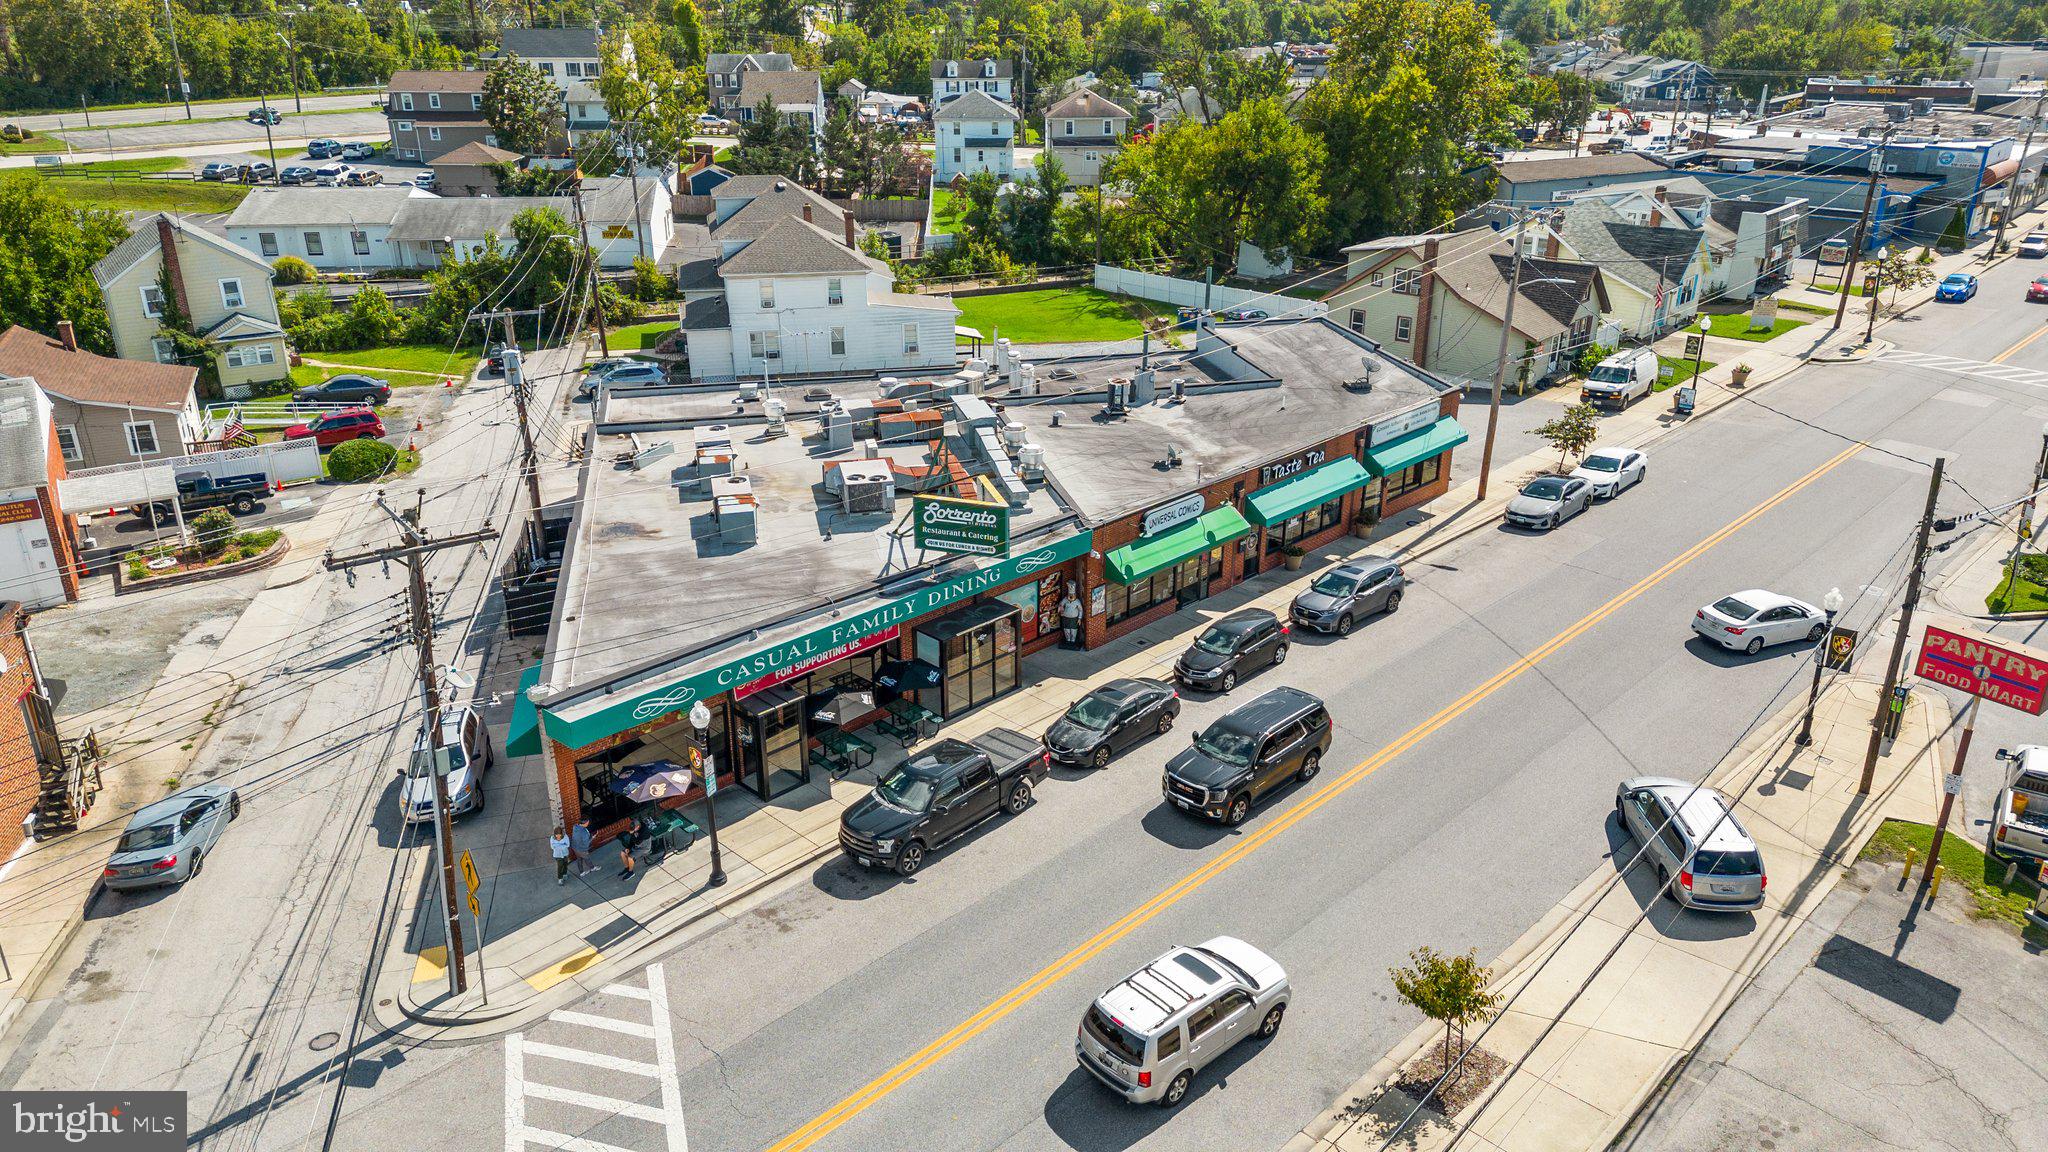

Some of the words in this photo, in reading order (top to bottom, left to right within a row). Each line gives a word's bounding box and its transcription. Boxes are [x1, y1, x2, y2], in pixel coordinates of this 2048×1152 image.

[1271, 458, 1302, 479] Taste
[1305, 450, 1325, 466] Tea
[923, 502, 997, 524] Sorrento
[1149, 509, 1177, 529] UNIVERSAL
[1178, 501, 1200, 517] COMICS
[922, 526, 961, 537] Restaurant
[968, 531, 999, 543] Catering
[955, 542, 971, 550] LUNCH
[717, 638, 818, 685] CASUAL
[831, 598, 918, 644] FAMILY
[928, 568, 1001, 606] DINING
[775, 664, 793, 679] FOR
[794, 644, 847, 672] SUPPORTING
[849, 638, 862, 650] US.
[1926, 635, 2047, 681] PANTRY
[1921, 662, 1971, 689] FOOD
[1978, 681, 2036, 710] MART
